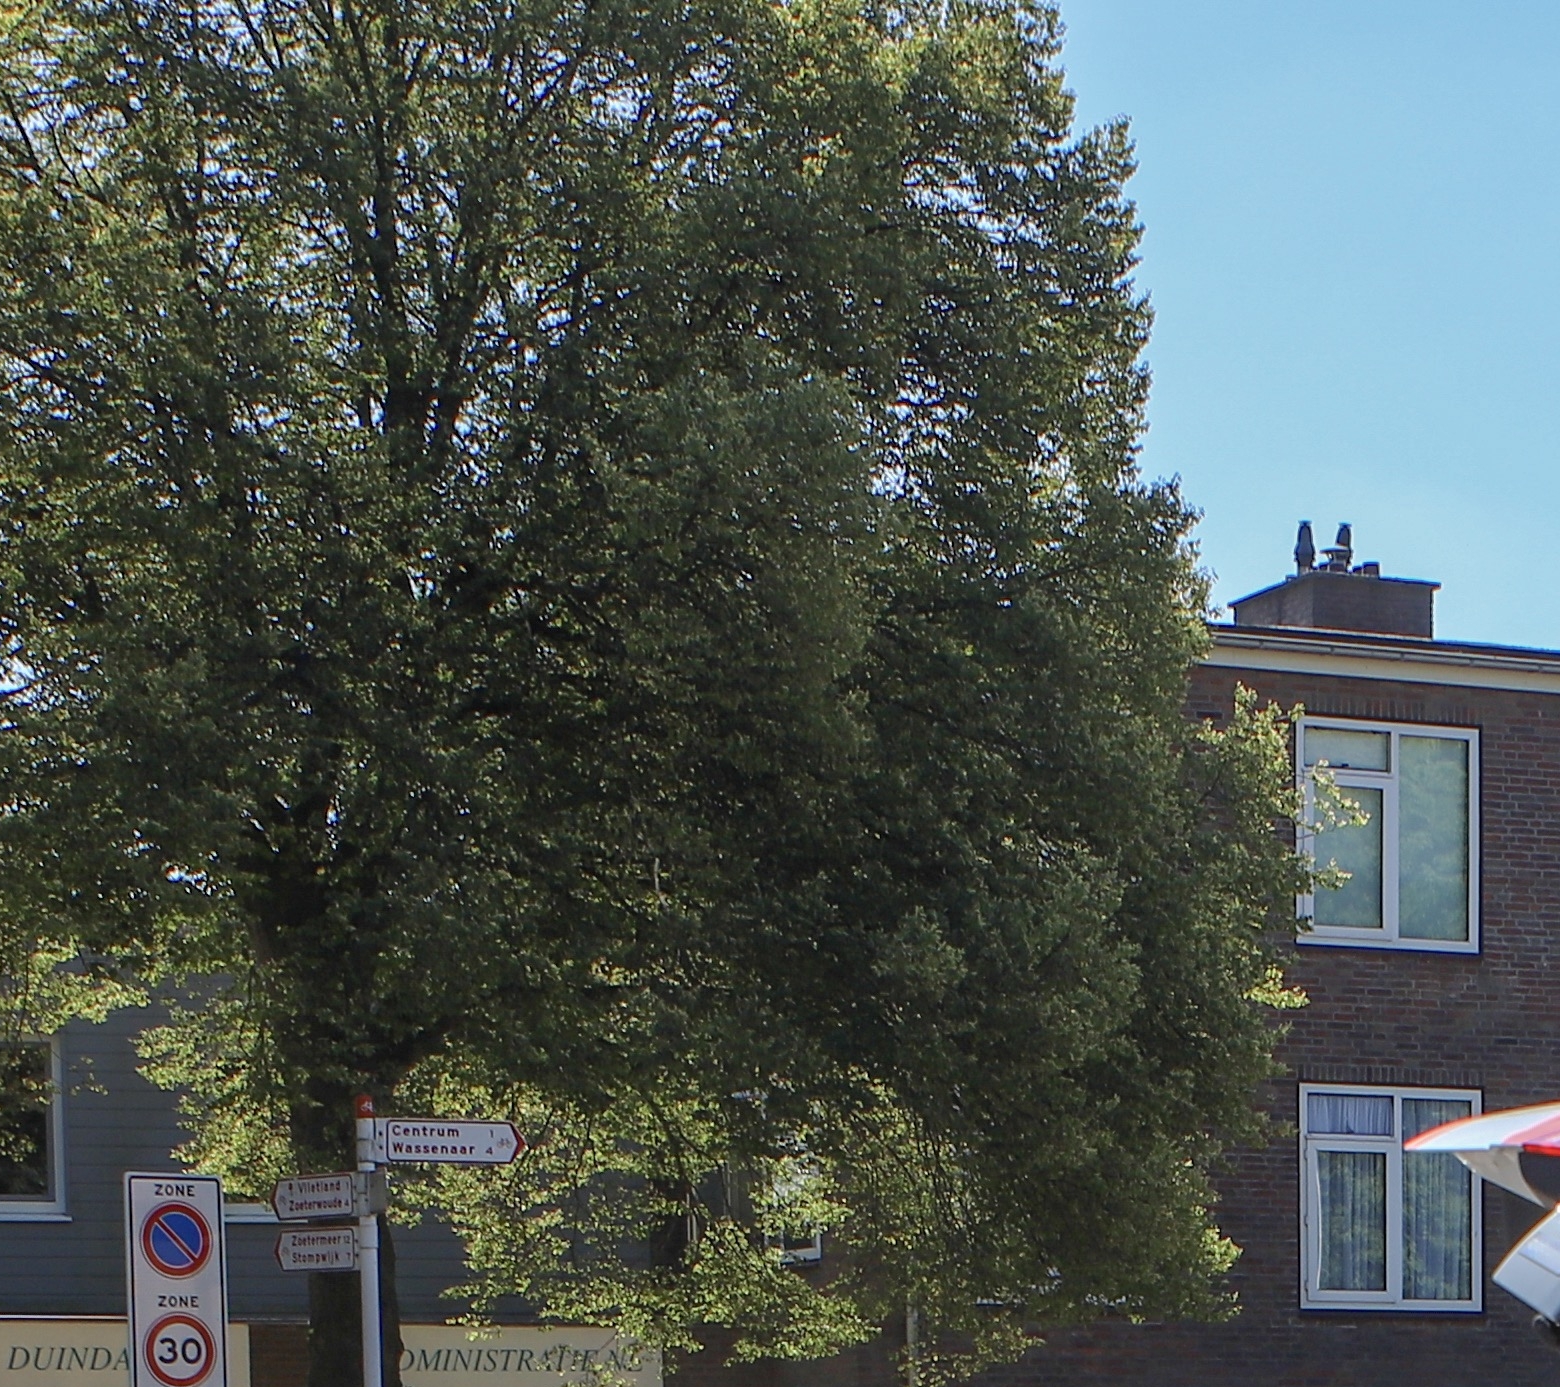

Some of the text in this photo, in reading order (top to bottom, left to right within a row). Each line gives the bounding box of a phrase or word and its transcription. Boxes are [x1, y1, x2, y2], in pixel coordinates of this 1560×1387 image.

[392, 1125, 460, 1138] Centrum
[392, 1142, 476, 1155] Wassenaar
[153, 1183, 196, 1197] ZONE
[289, 1197, 342, 1212] Zoeterwoude
[291, 1235, 342, 1247] Zoetermeer
[291, 1250, 340, 1265] Stompwijk
[157, 1295, 200, 1308] ZONE
[157, 1337, 203, 1365] 30
[7, 1346, 130, 1371] DUINDA
